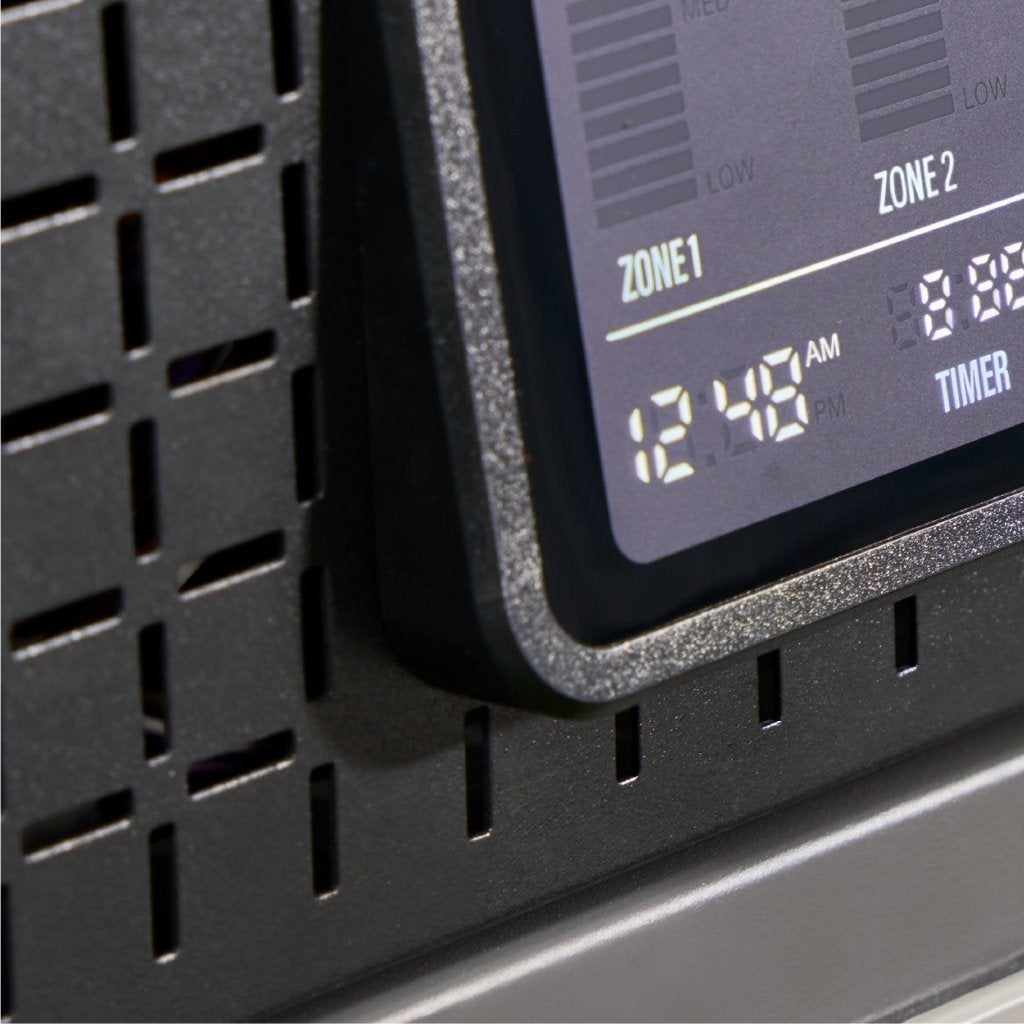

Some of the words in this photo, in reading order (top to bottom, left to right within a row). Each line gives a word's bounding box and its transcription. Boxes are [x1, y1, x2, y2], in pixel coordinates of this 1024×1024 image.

[963, 76, 1009, 111] LOW
[706, 159, 756, 195] LOW
[874, 155, 939, 215] ZONE
[940, 150, 958, 192] 2
[617, 240, 689, 304] ZONE
[686, 233, 703, 279] 1
[805, 332, 841, 367] AM
[934, 349, 1012, 414] TIMER
[814, 393, 846, 421] PM
